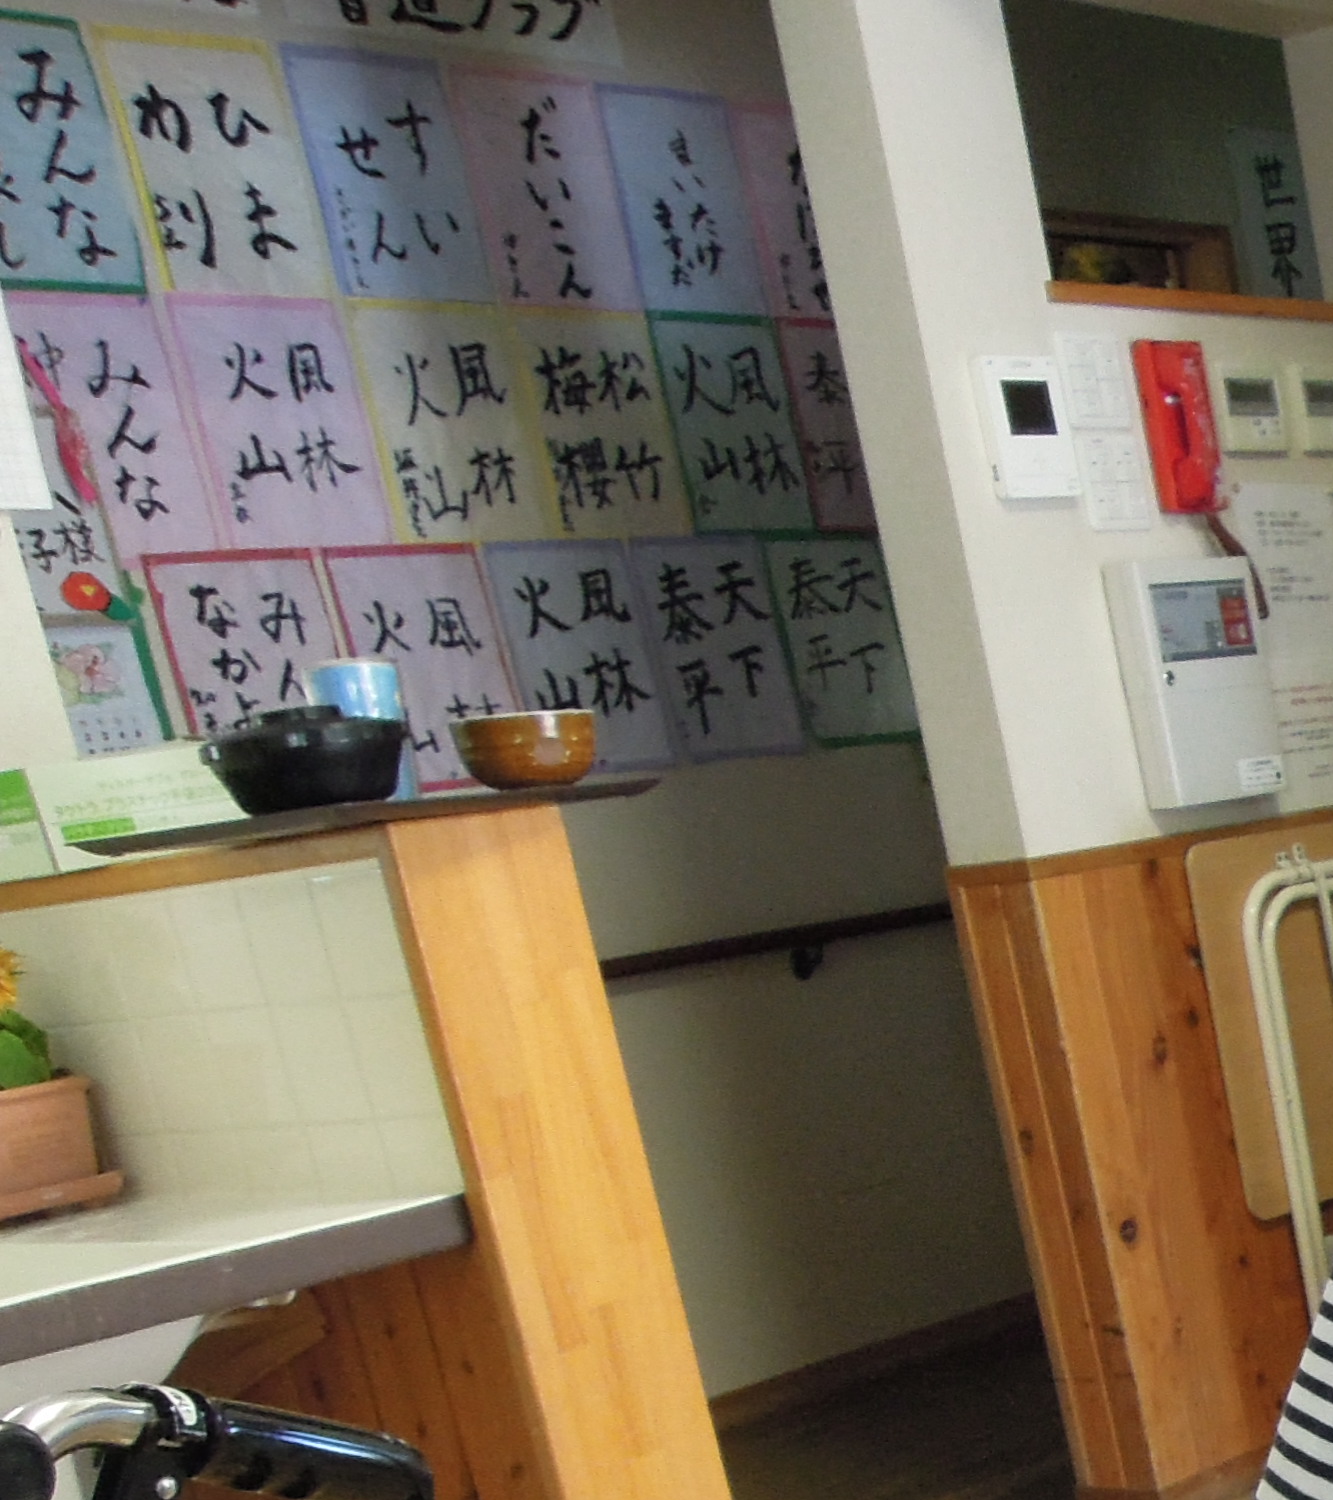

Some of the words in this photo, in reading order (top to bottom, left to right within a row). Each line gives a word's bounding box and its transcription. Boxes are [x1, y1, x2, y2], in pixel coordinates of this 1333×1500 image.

[15, 50, 117, 266] みんな
[88, 339, 169, 521] みんな
